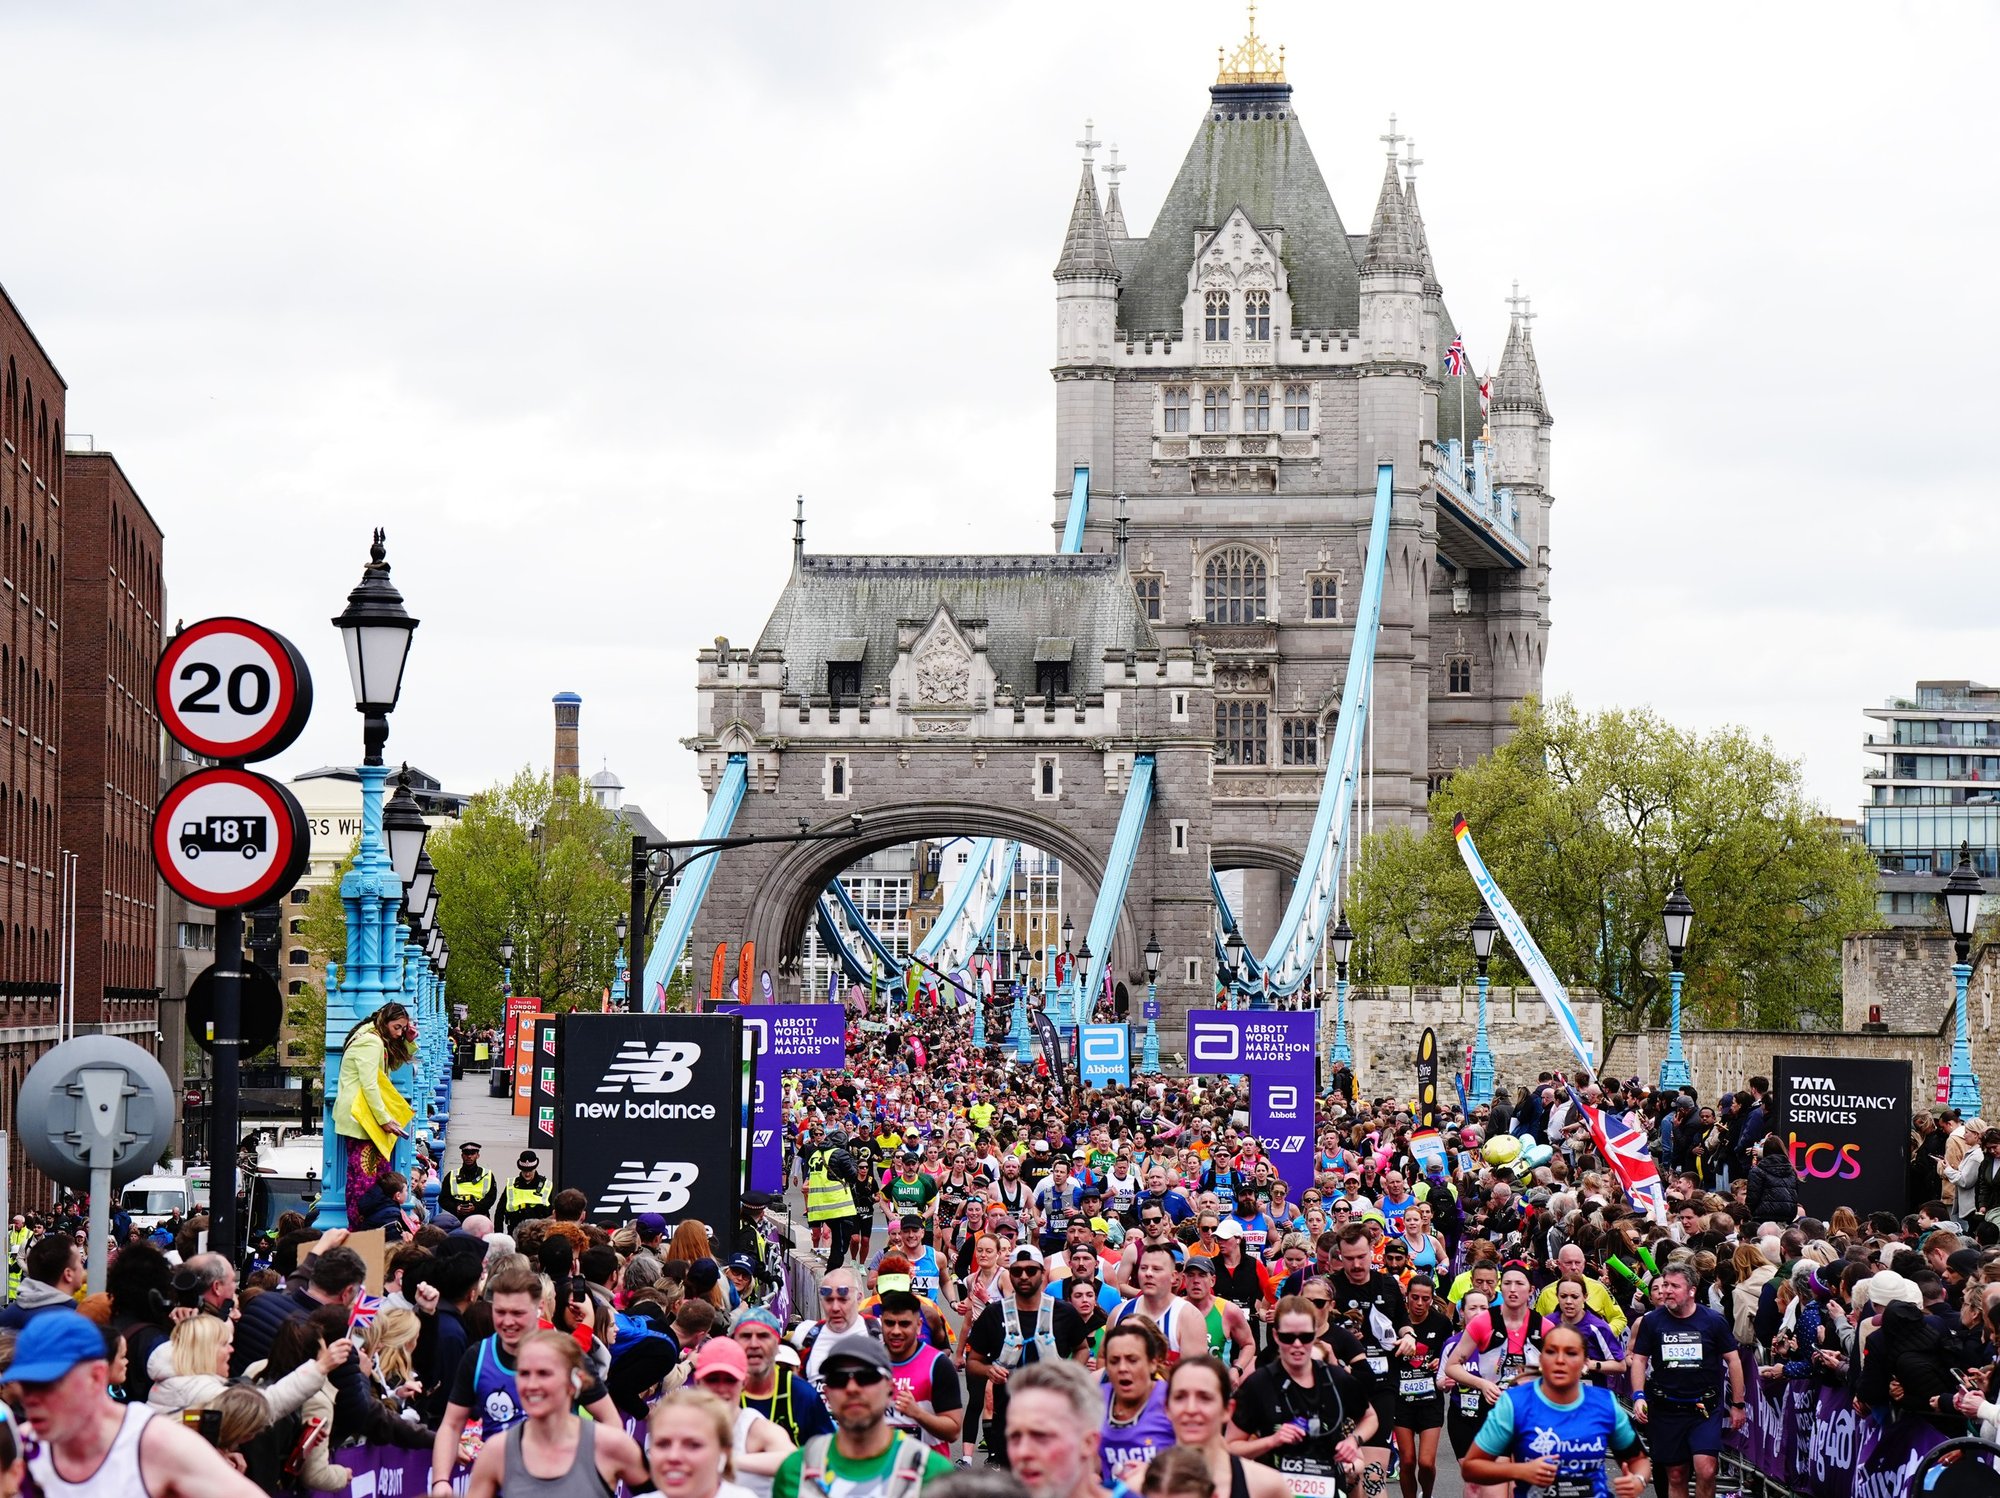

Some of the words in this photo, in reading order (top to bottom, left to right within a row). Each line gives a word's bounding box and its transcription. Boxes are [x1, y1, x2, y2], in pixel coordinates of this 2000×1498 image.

[179, 663, 270, 715] 20
[774, 1019, 817, 1027] ABBOTT
[774, 1028, 814, 1036] WORLD
[1246, 1025, 1288, 1033] ABBOTT
[774, 1037, 839, 1045] MARATHON
[1246, 1034, 1284, 1042] WORLD
[774, 1046, 820, 1054] MAJORS
[1246, 1044, 1310, 1052] MARATHON
[1246, 1053, 1291, 1061] MAJORS
[1086, 1064, 1124, 1074] Abbott
[1419, 1064, 1431, 1077] Shine
[1790, 1077, 1835, 1091] TATA
[1790, 1094, 1896, 1110] CONSULTANCY
[576, 1102, 620, 1118] new
[625, 1100, 716, 1119] balance
[1790, 1110, 1856, 1125] SERVICES
[1789, 1132, 1861, 1180] tcs
[1664, 1334, 1678, 1342] tcs
[1668, 1348, 1696, 1357] 53342
[1400, 1370, 1412, 1378] tcs
[1404, 1381, 1429, 1392] 64287
[1556, 1436, 1604, 1452] mind
[1282, 1457, 1303, 1471] tcs
[1287, 1479, 1326, 1494] 26205
